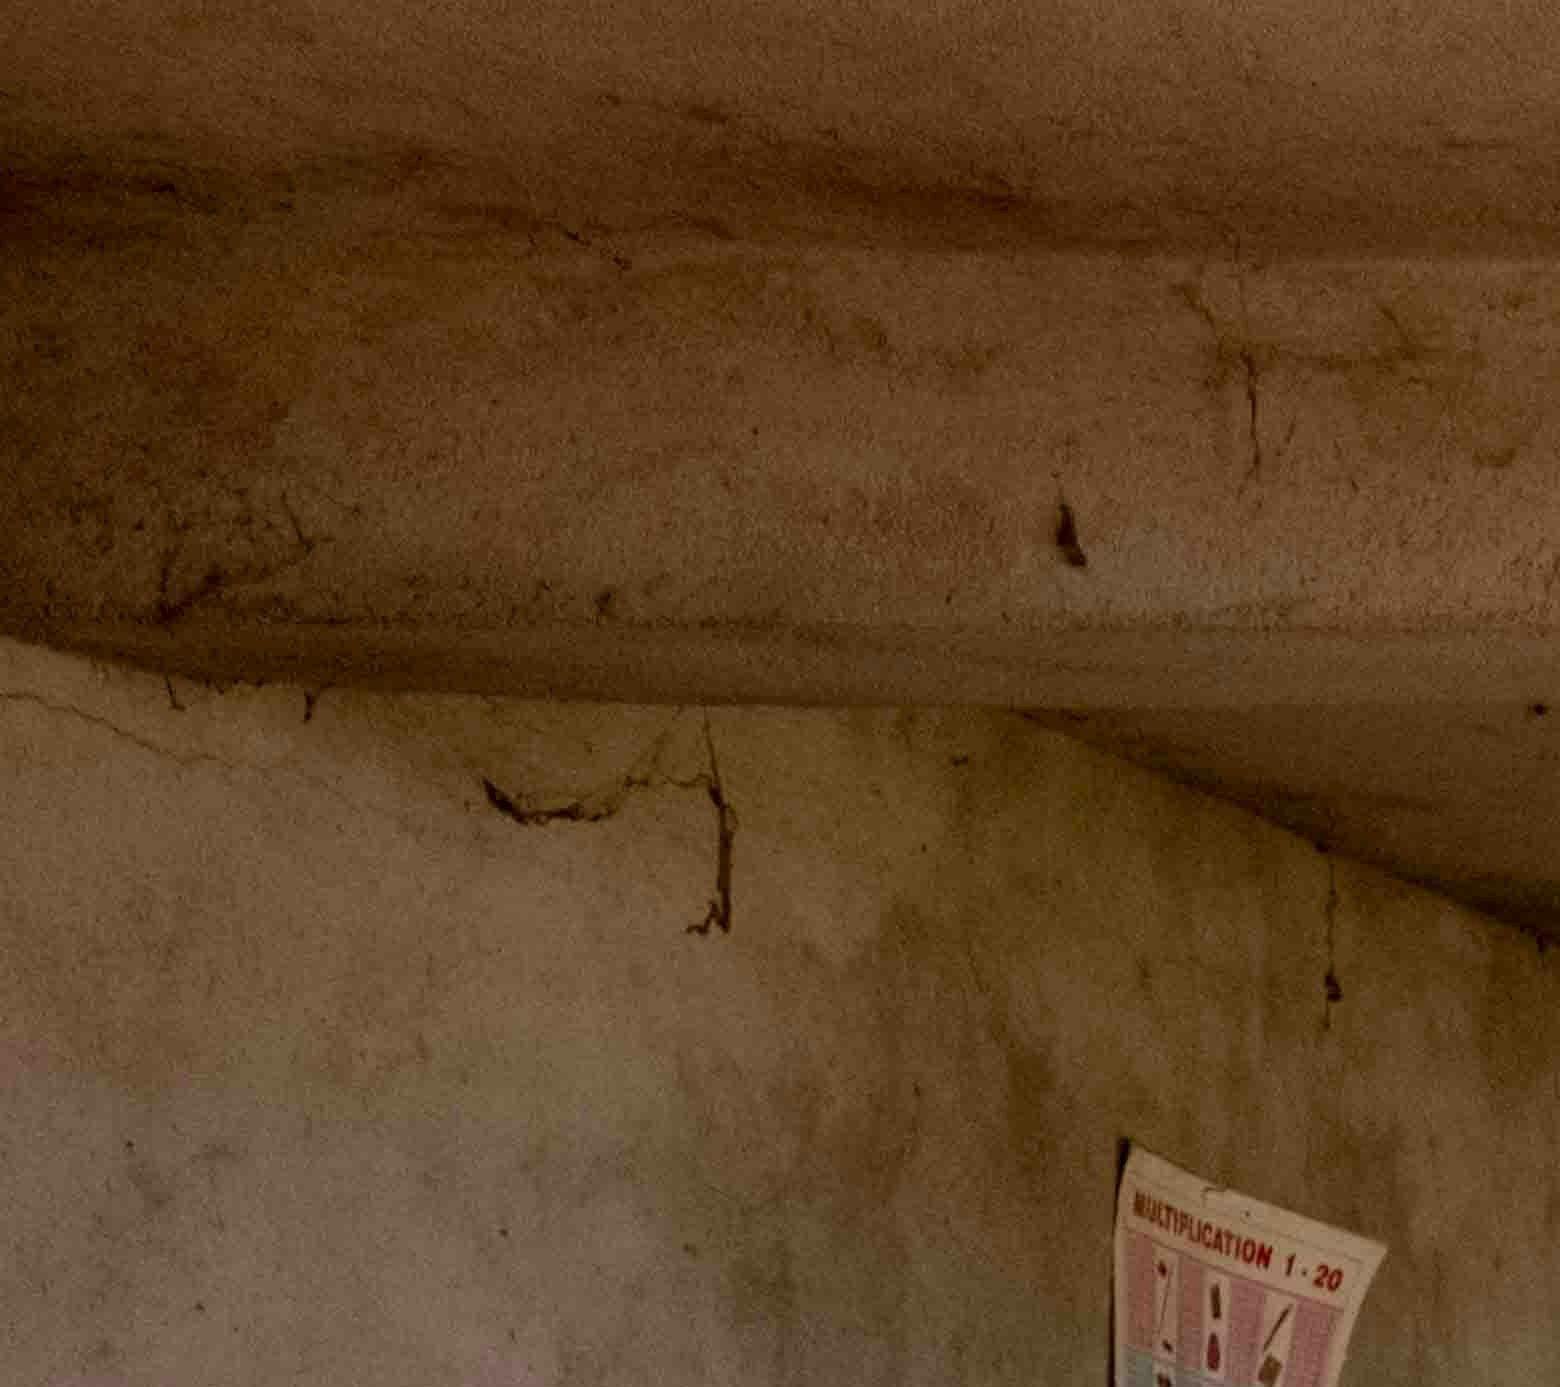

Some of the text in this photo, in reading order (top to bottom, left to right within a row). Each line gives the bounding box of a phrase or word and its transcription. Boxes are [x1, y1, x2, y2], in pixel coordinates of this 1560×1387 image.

[1133, 1191, 1273, 1270] MULTIPLICATION
[1284, 1252, 1296, 1278] 1
[1312, 1264, 1344, 1291] 20
